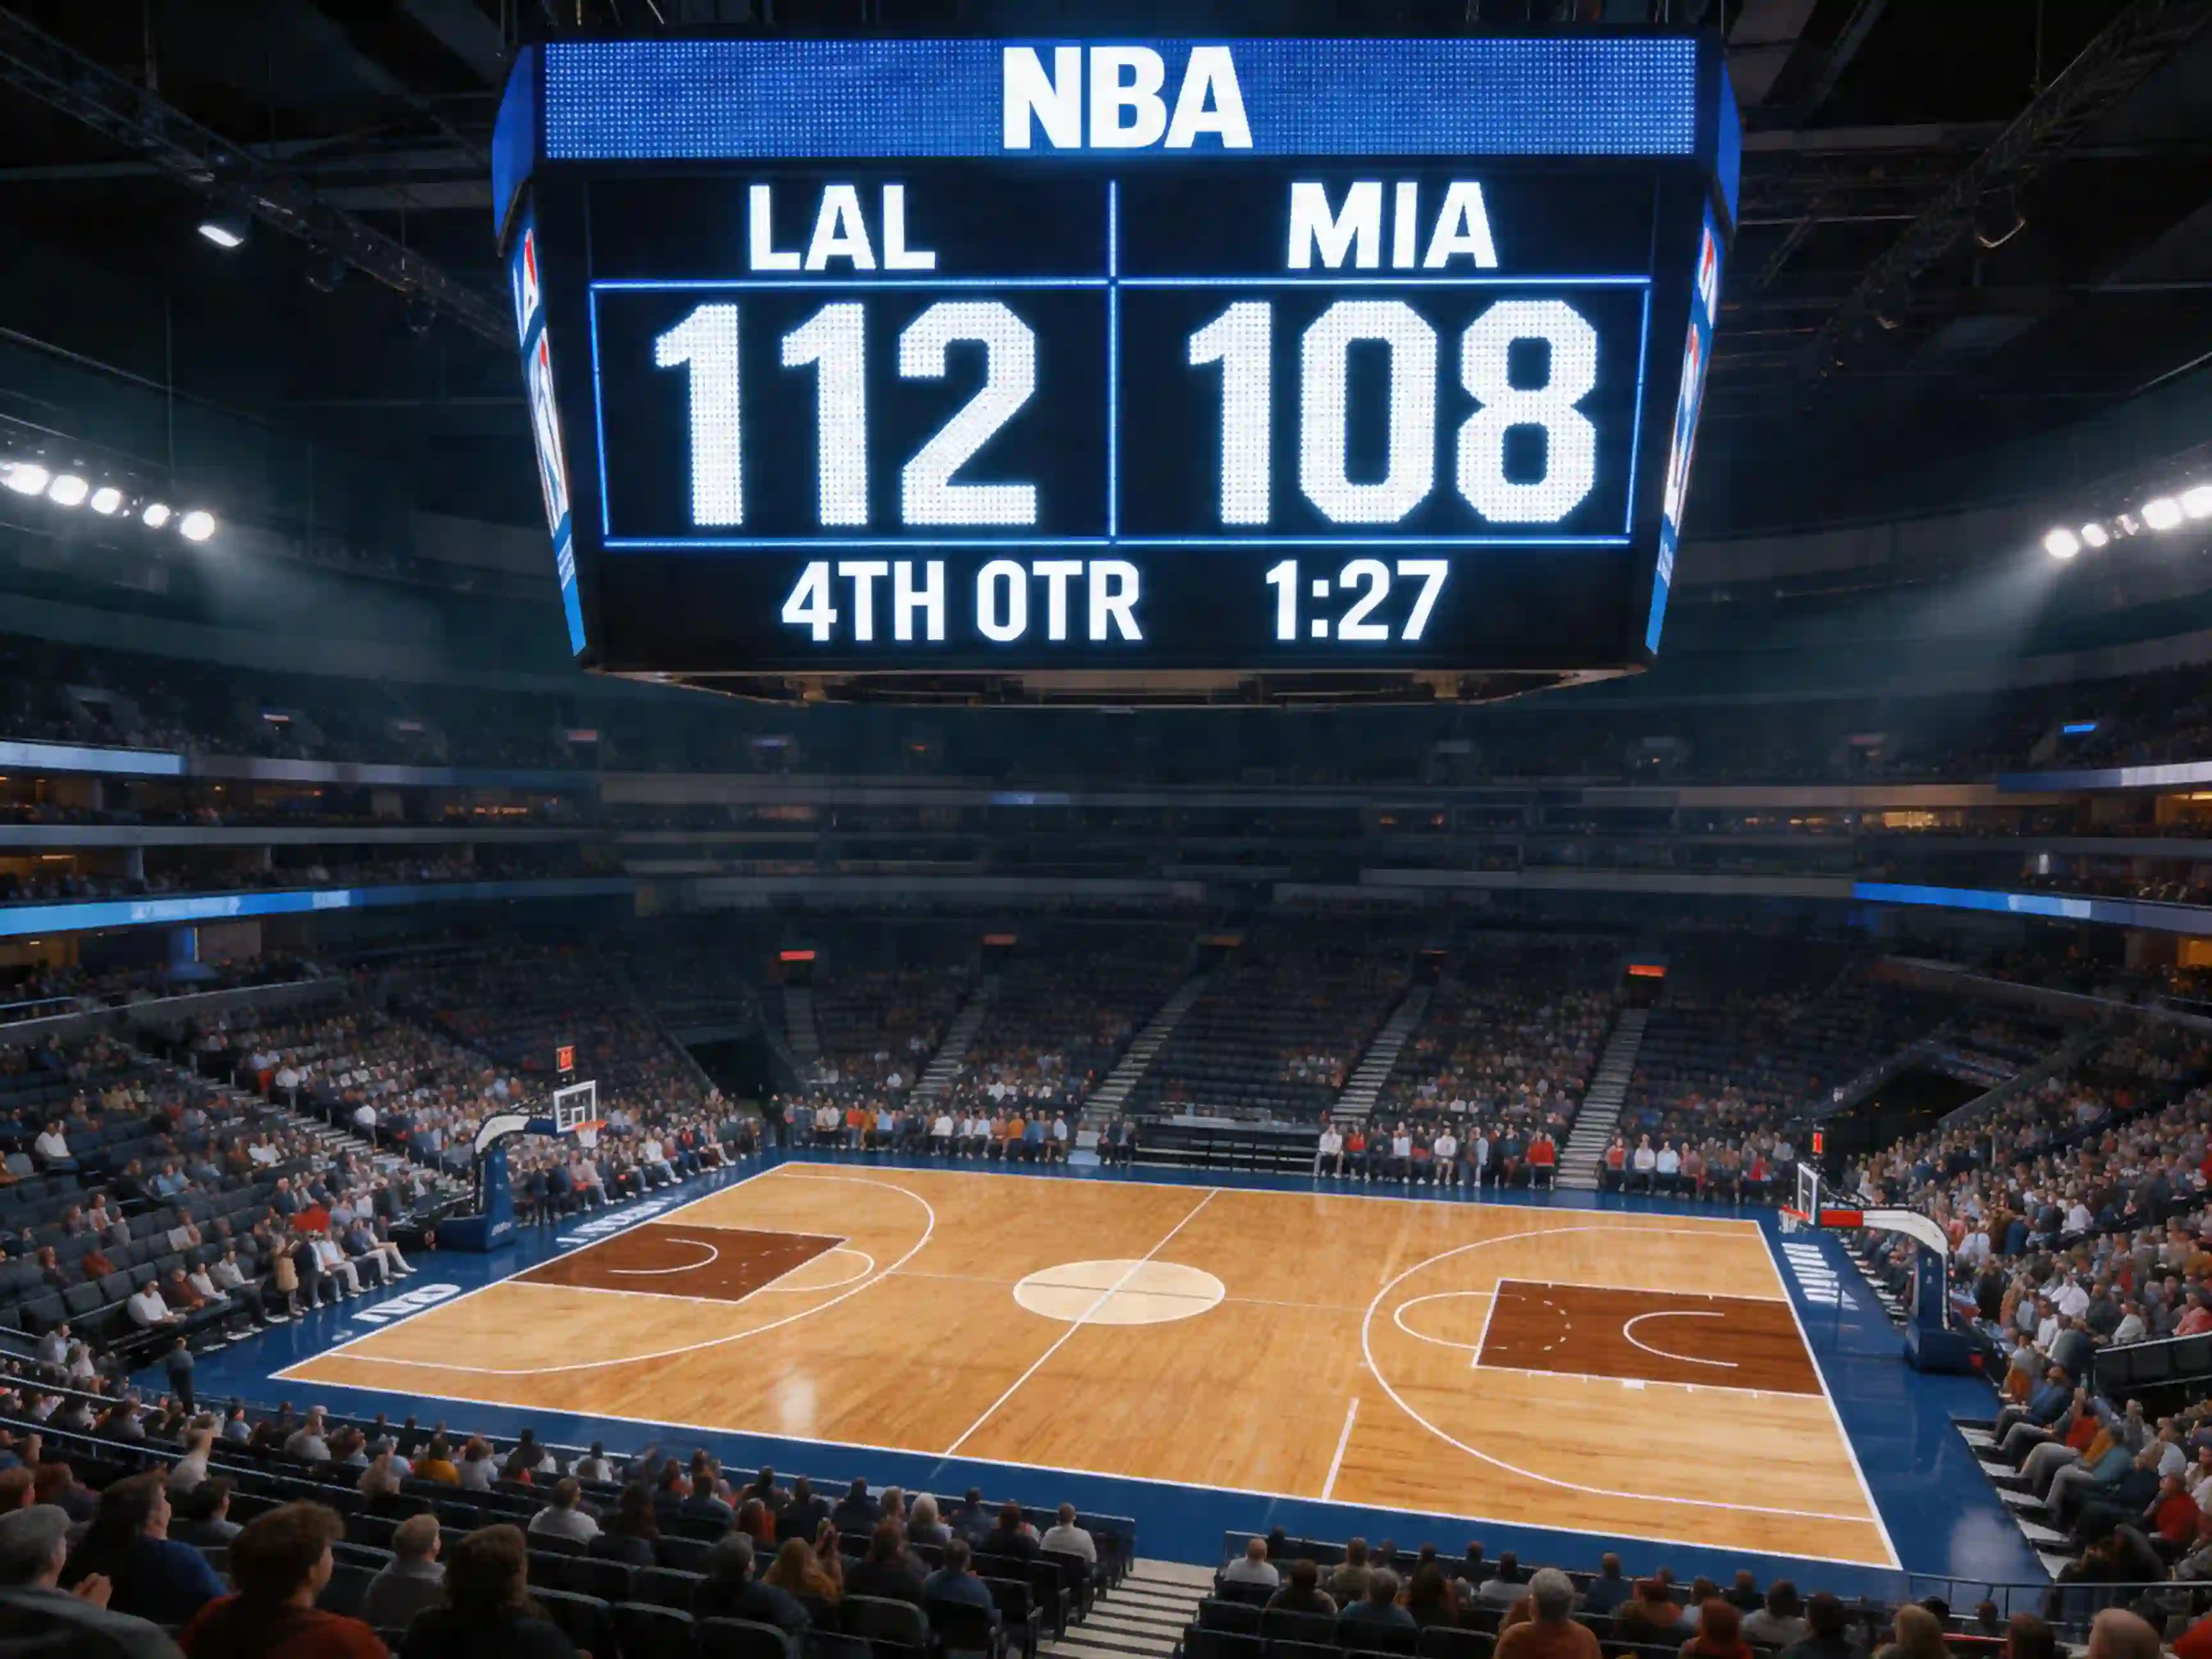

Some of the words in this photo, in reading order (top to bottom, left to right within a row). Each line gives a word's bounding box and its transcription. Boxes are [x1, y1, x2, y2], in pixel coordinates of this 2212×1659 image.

[1003, 47, 1253, 148] NBA
[749, 184, 936, 271] LAL
[1286, 180, 1499, 269] MIA
[654, 301, 1038, 527] 112
[1188, 299, 1598, 525] 108
[781, 559, 945, 642] 4TH
[1265, 558, 1449, 641] 1:27
